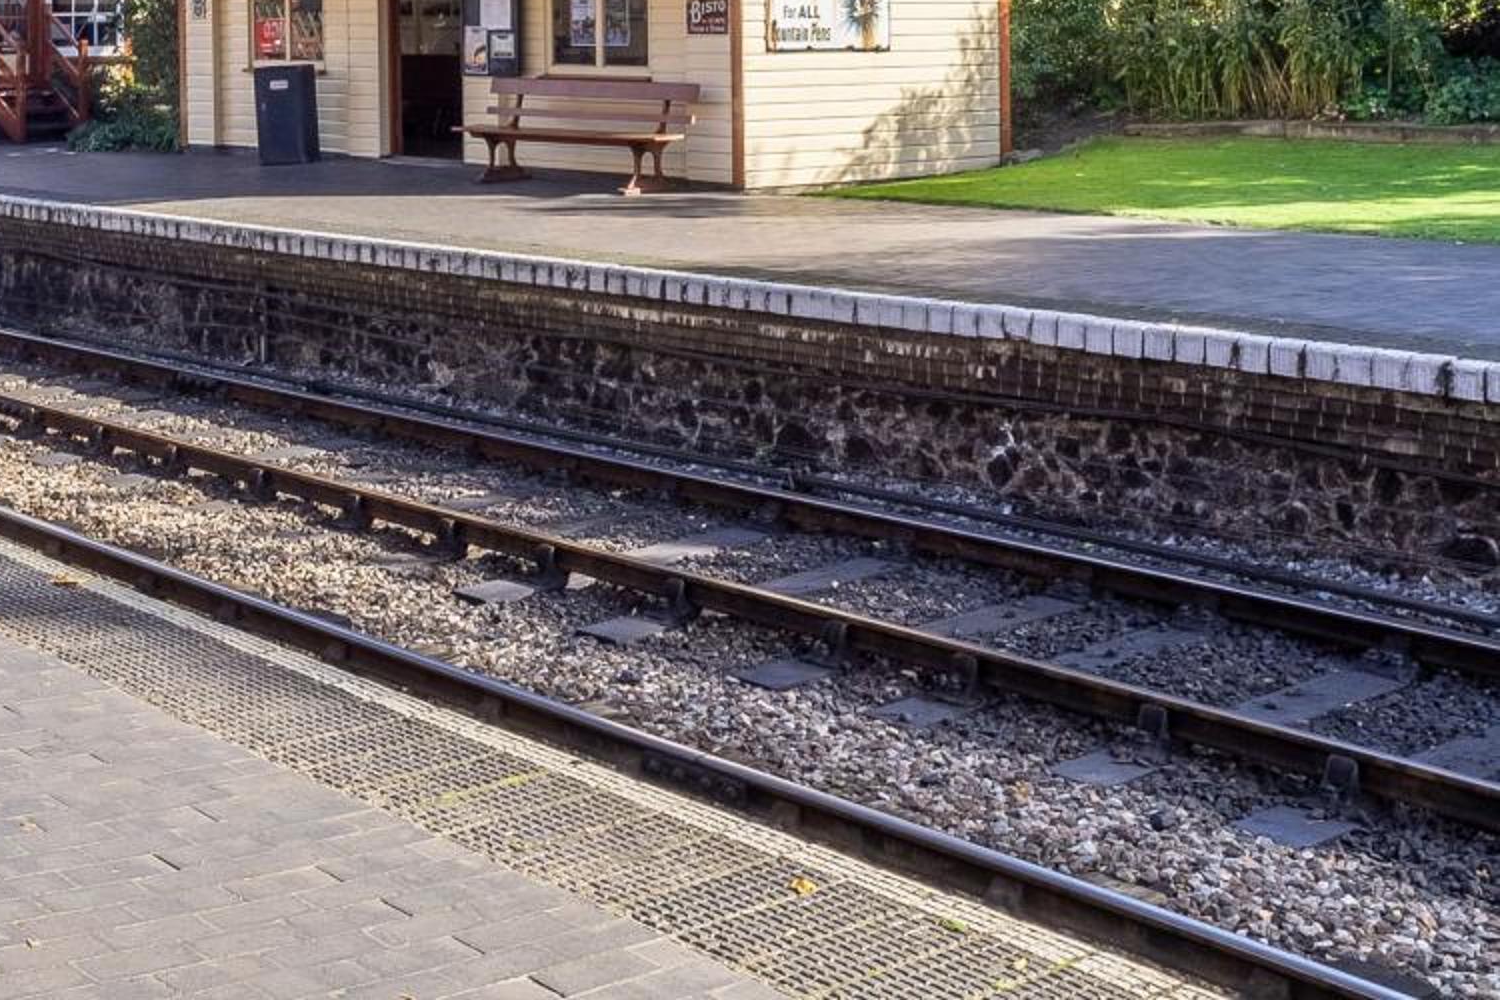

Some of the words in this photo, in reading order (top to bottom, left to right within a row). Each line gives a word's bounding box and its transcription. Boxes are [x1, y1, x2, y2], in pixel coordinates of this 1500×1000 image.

[690, 0, 726, 24] BISTO
[798, 4, 820, 18] ALL
[811, 25, 831, 41] Pens
